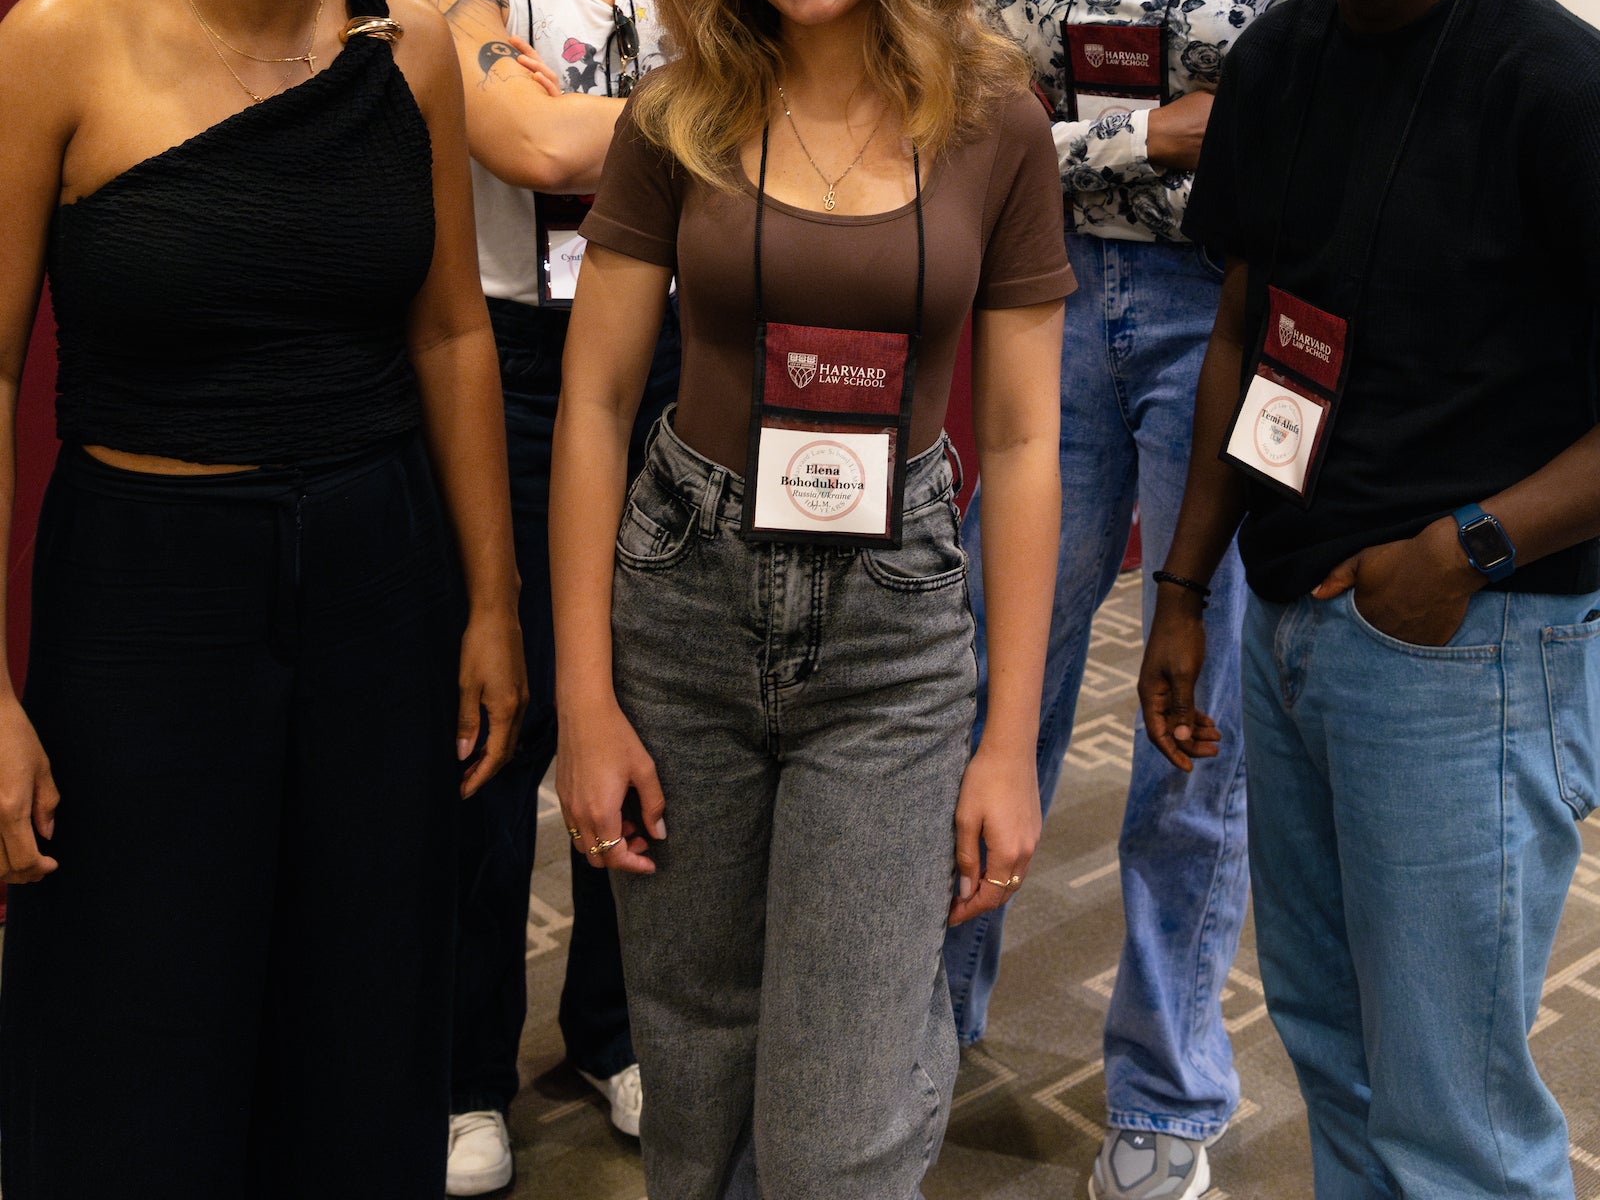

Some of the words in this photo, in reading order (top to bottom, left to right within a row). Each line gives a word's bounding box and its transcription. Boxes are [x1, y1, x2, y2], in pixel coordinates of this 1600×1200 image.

[1105, 51, 1149, 60] HARVARD
[1293, 329, 1332, 355] HARVARD
[1305, 345, 1330, 363] SCHOOL
[820, 363, 886, 380] HARVARD
[819, 375, 840, 384] LAW
[843, 377, 885, 388] SCHOOL
[806, 464, 840, 475] Elena
[780, 476, 864, 490] Bohodukhova
[792, 489, 852, 500] Russia/Ukraine
